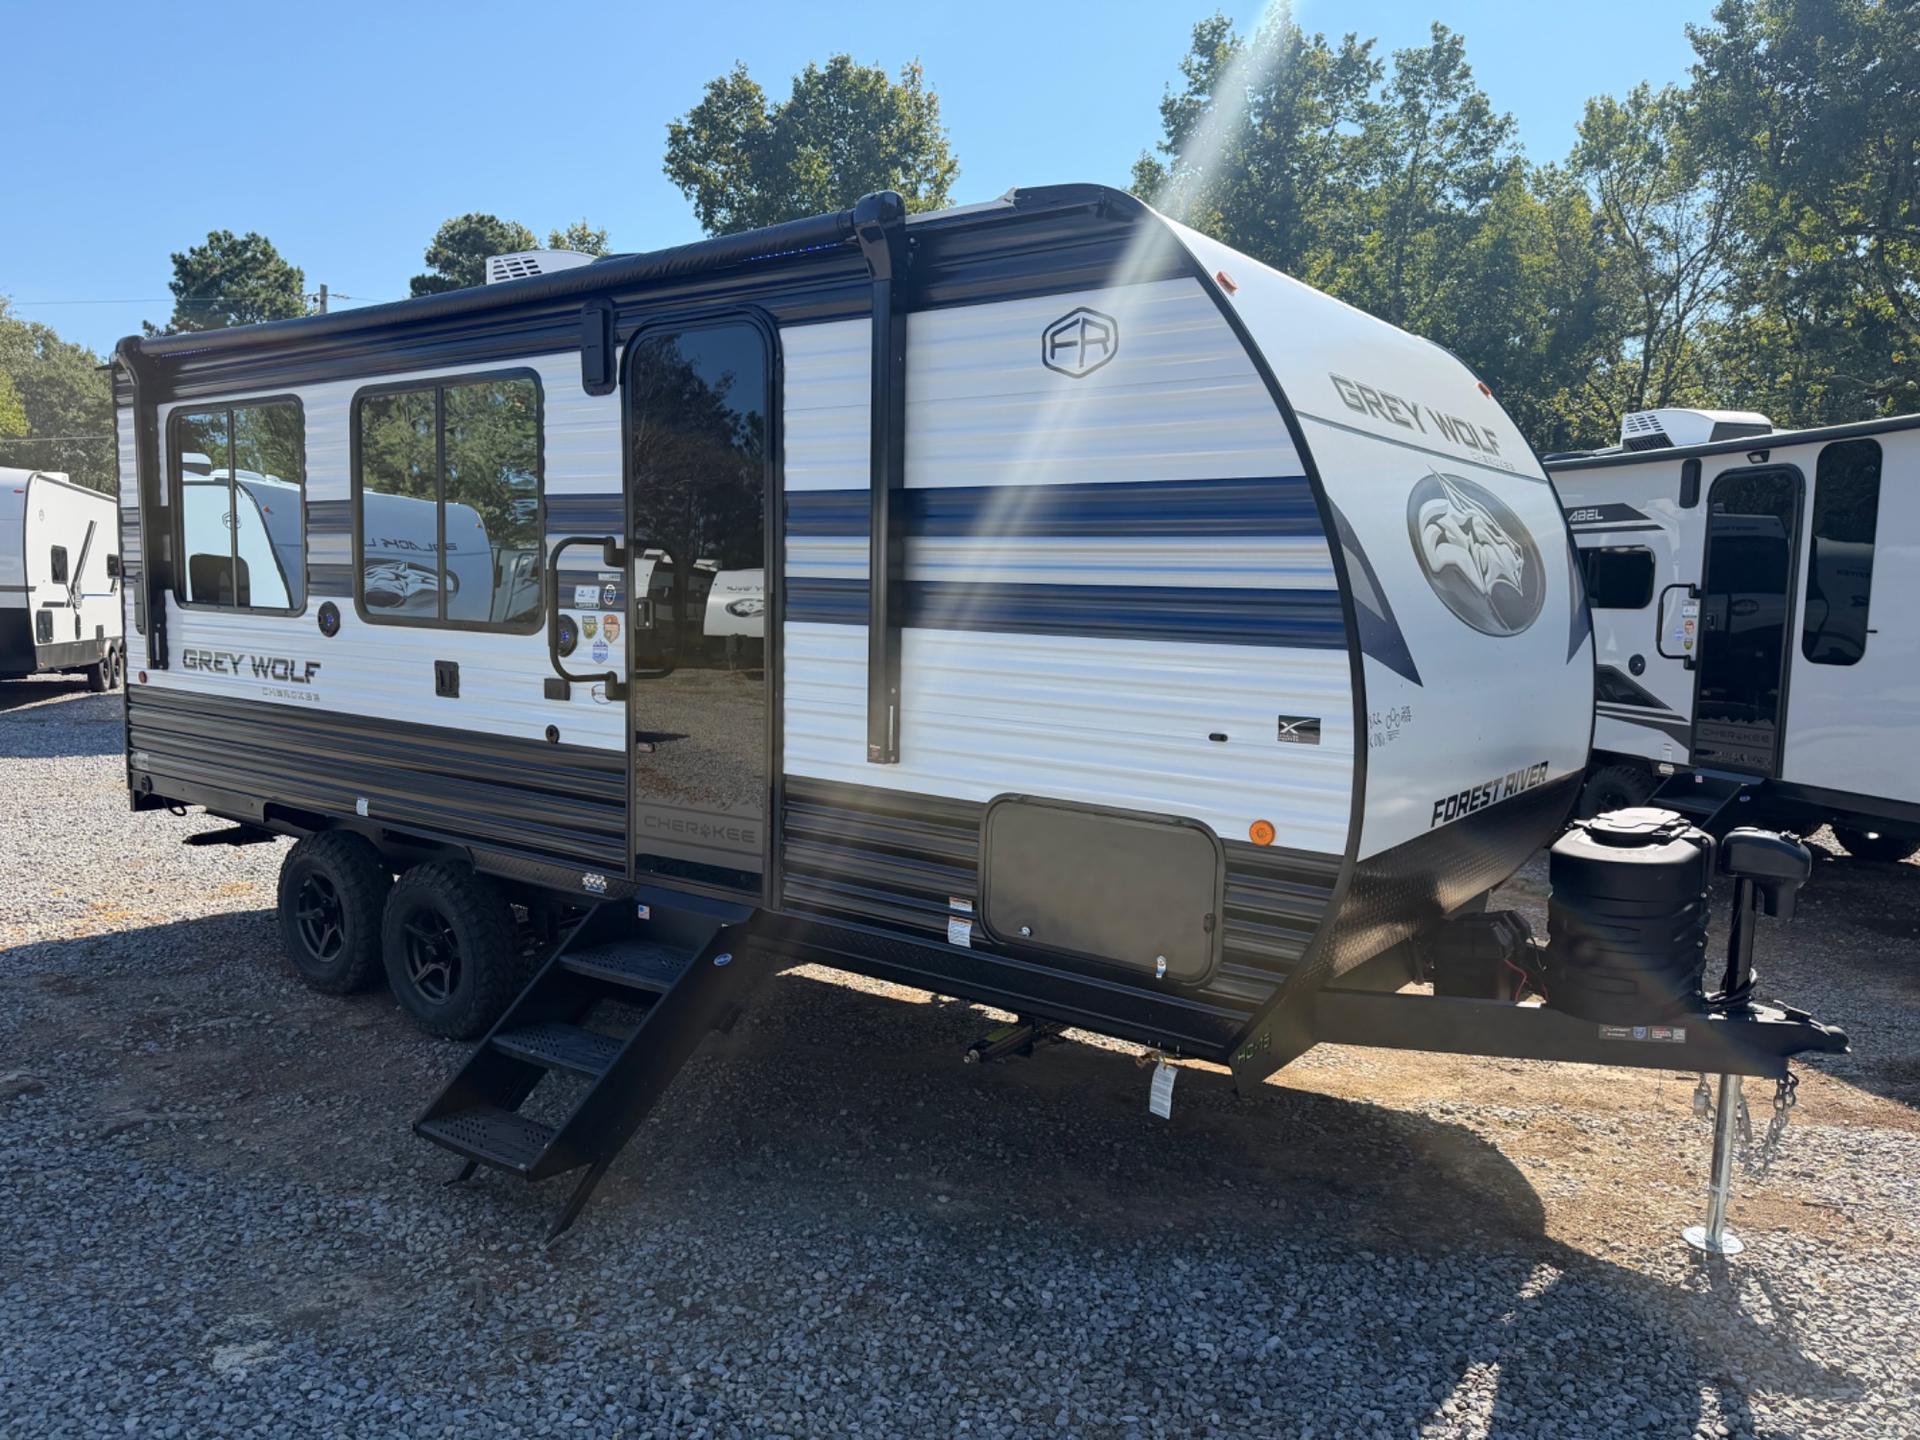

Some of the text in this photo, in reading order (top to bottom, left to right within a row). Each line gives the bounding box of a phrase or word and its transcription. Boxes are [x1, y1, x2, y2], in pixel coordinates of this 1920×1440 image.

[1328, 372, 1501, 457] GREY WOLF
[183, 648, 322, 684] GREY WOLF
[1431, 760, 1549, 828] FOREST RIVER
